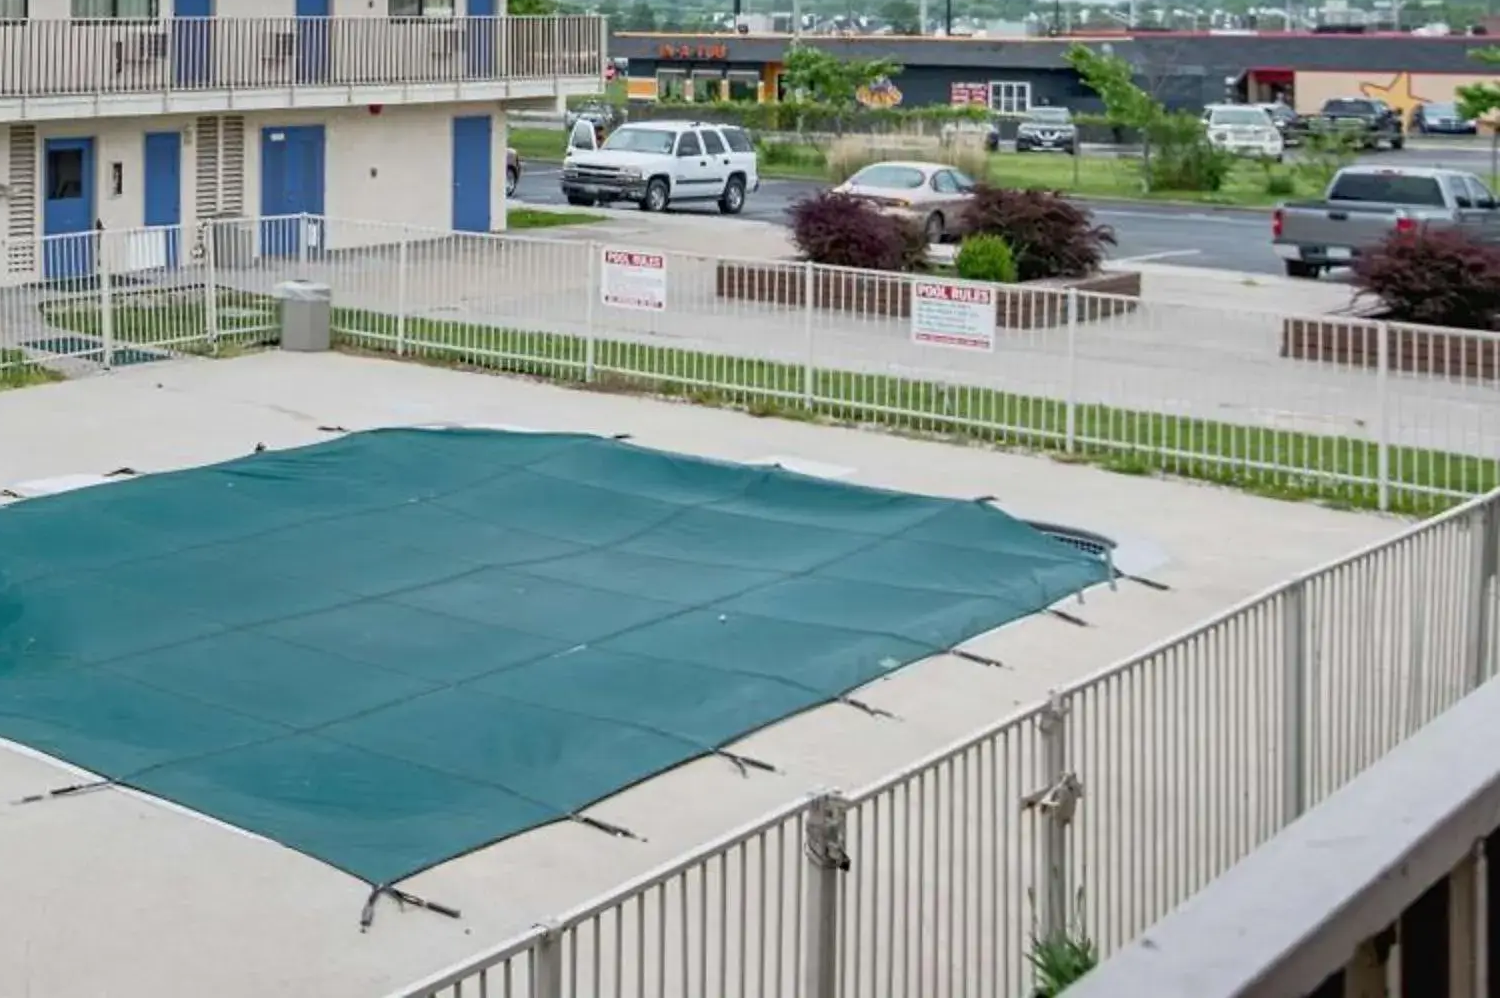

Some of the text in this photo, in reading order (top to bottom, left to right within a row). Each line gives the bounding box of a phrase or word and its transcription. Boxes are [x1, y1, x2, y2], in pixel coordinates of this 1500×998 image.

[608, 252, 661, 268] POOL RULES
[918, 283, 989, 303] POOL RULES
